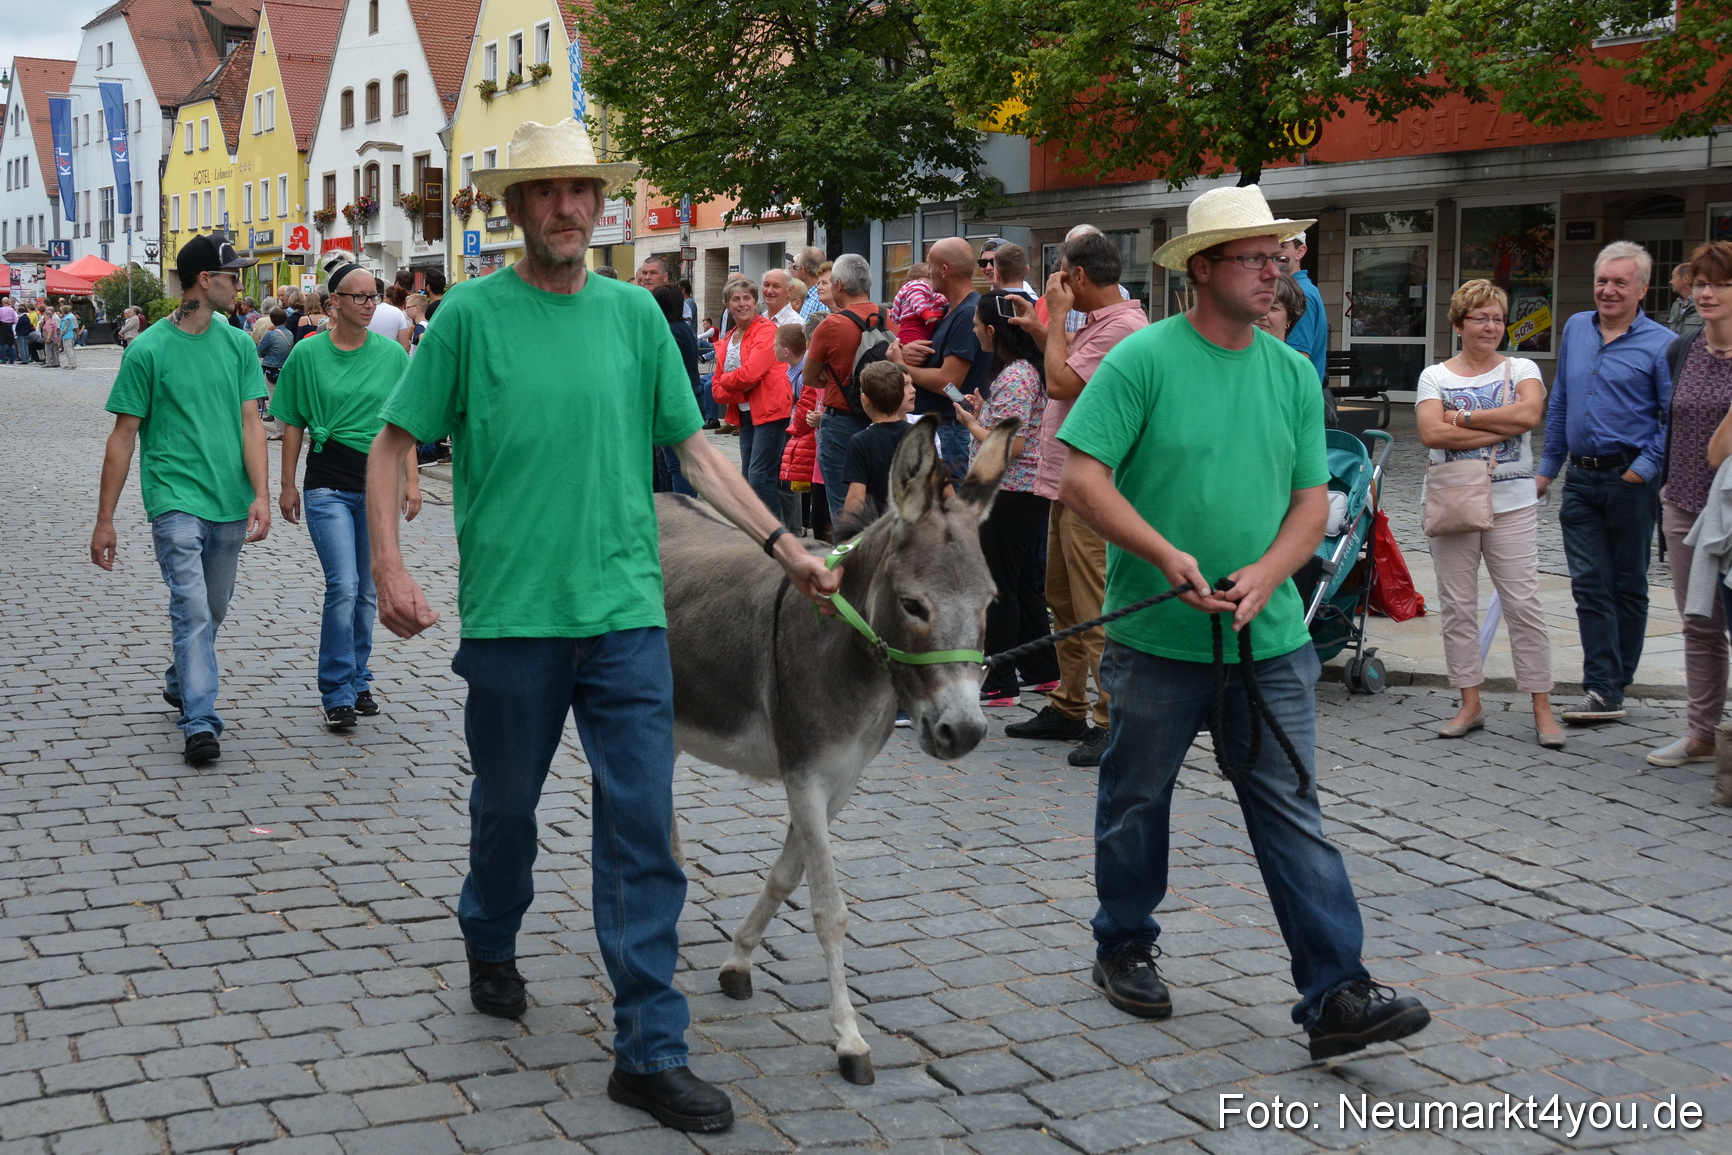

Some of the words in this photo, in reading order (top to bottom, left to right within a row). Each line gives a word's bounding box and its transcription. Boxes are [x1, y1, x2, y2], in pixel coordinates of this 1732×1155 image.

[1368, 107, 1469, 152] JOSEF
[193, 169, 211, 186] HOTEL
[255, 231, 270, 243] AIFUN
[467, 233, 477, 252] P
[1514, 320, 1534, 342] 50%
